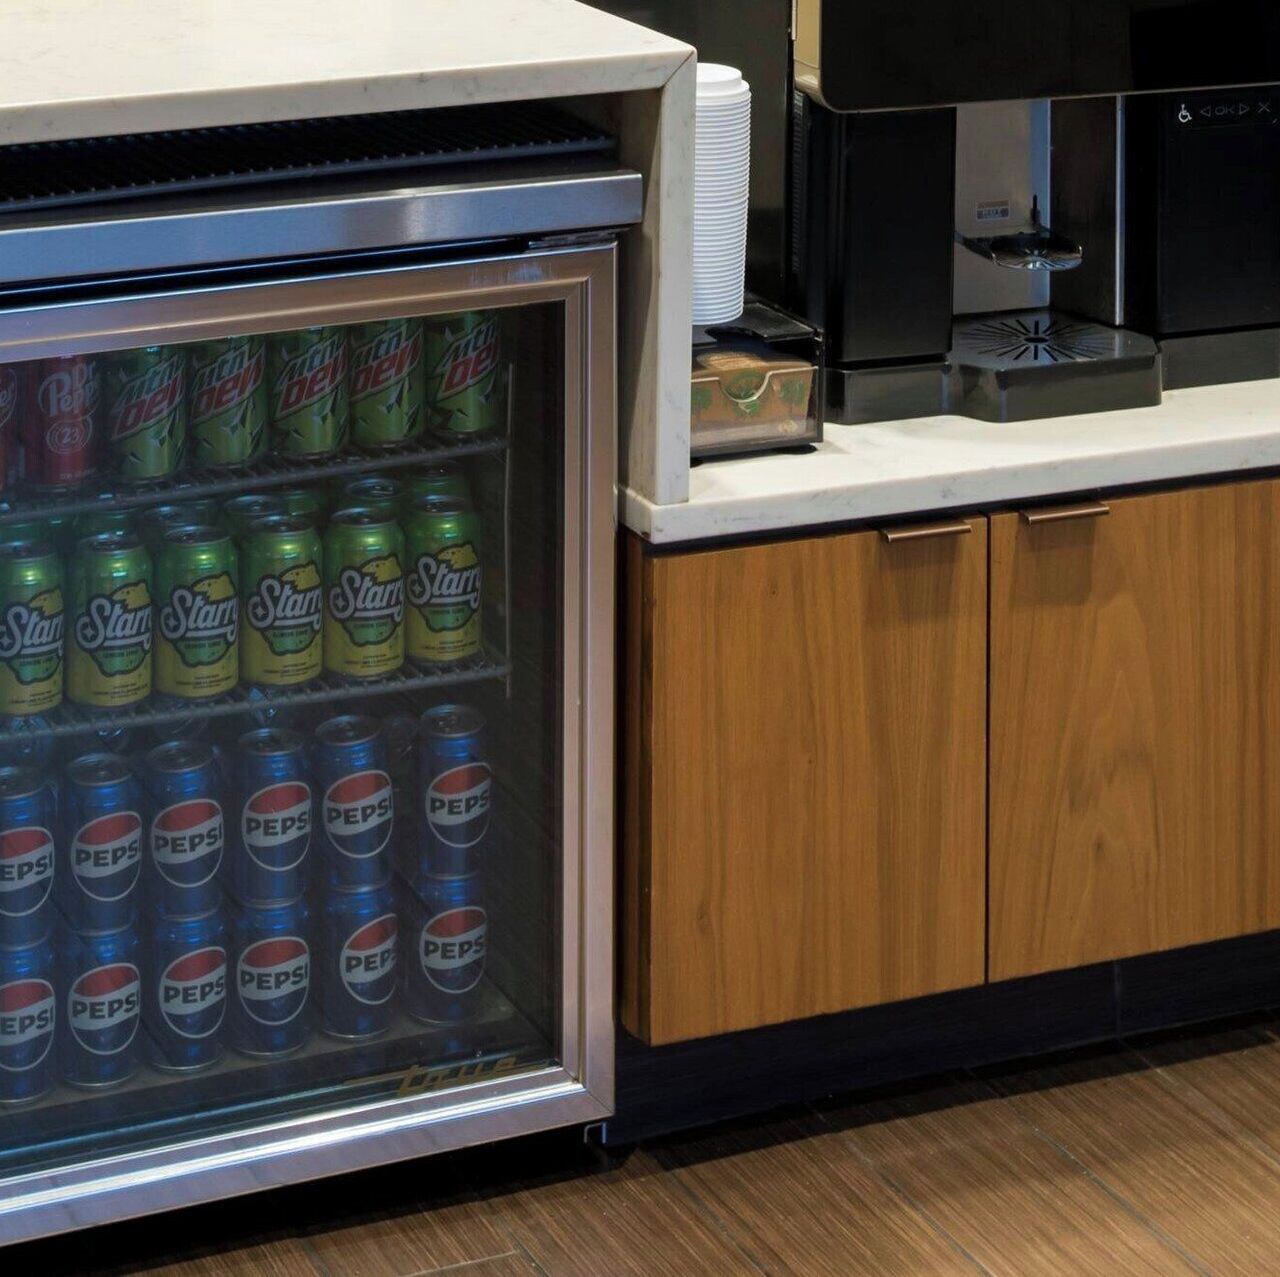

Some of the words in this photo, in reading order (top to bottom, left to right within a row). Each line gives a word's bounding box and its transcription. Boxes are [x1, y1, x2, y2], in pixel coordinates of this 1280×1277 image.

[328, 800, 393, 825] PEPSI
[154, 826, 222, 854] PEPSI
[163, 975, 225, 1004] PEPS
[240, 964, 308, 990] PEPSI
[72, 996, 140, 1019] PEPSI
